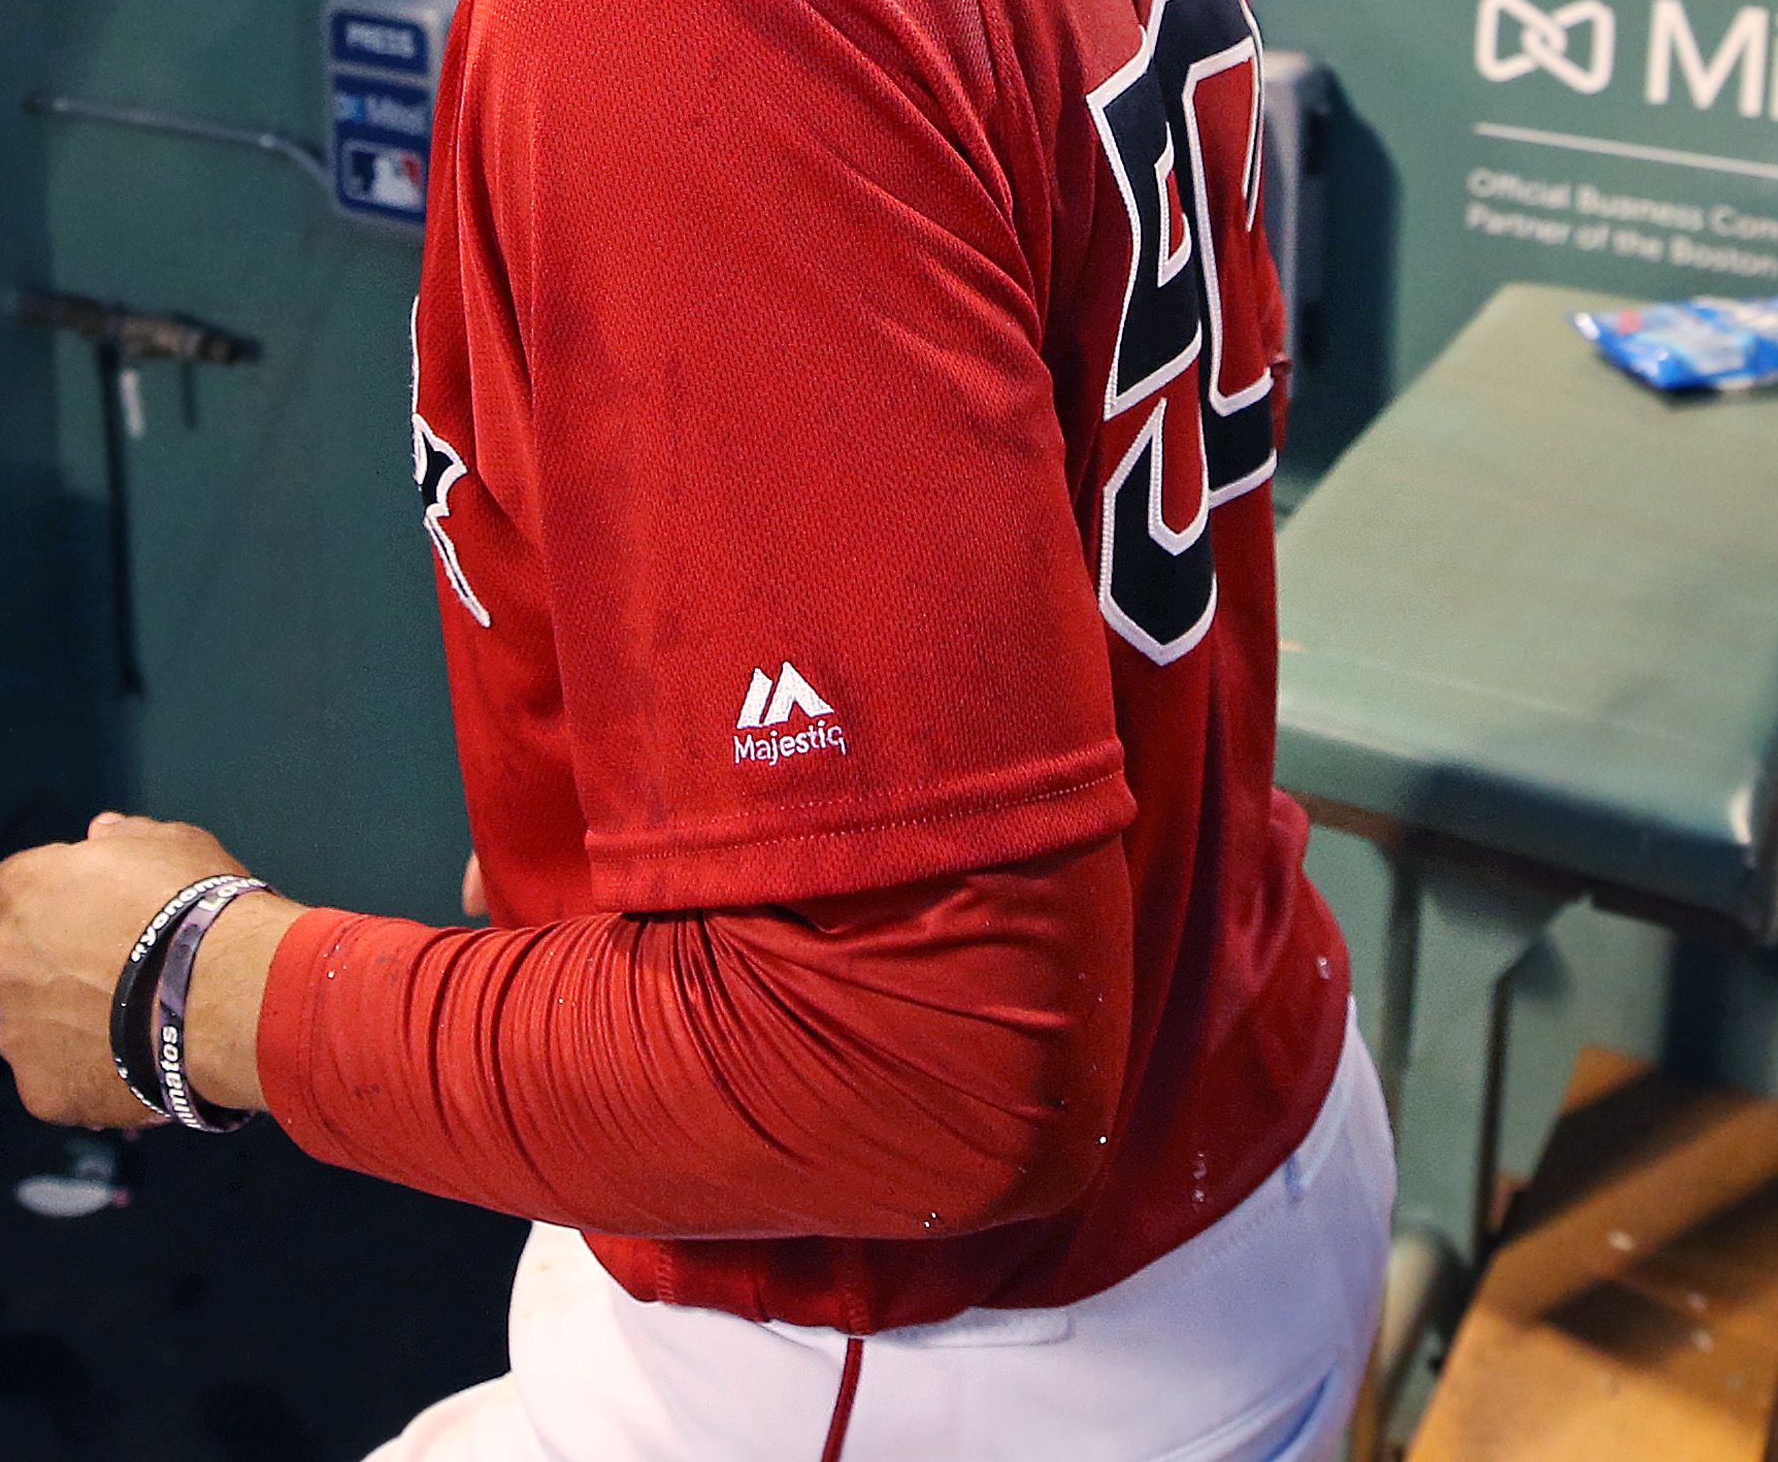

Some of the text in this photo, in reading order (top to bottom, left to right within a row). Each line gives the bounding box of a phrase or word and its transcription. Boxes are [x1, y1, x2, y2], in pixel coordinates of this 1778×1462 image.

[1466, 199, 1571, 246] Partner
[1573, 225, 1610, 252] of
[1610, 229, 1664, 262] the
[1468, 167, 1571, 210] Official
[1573, 182, 1705, 232] Business
[733, 719, 847, 767] Majestic
